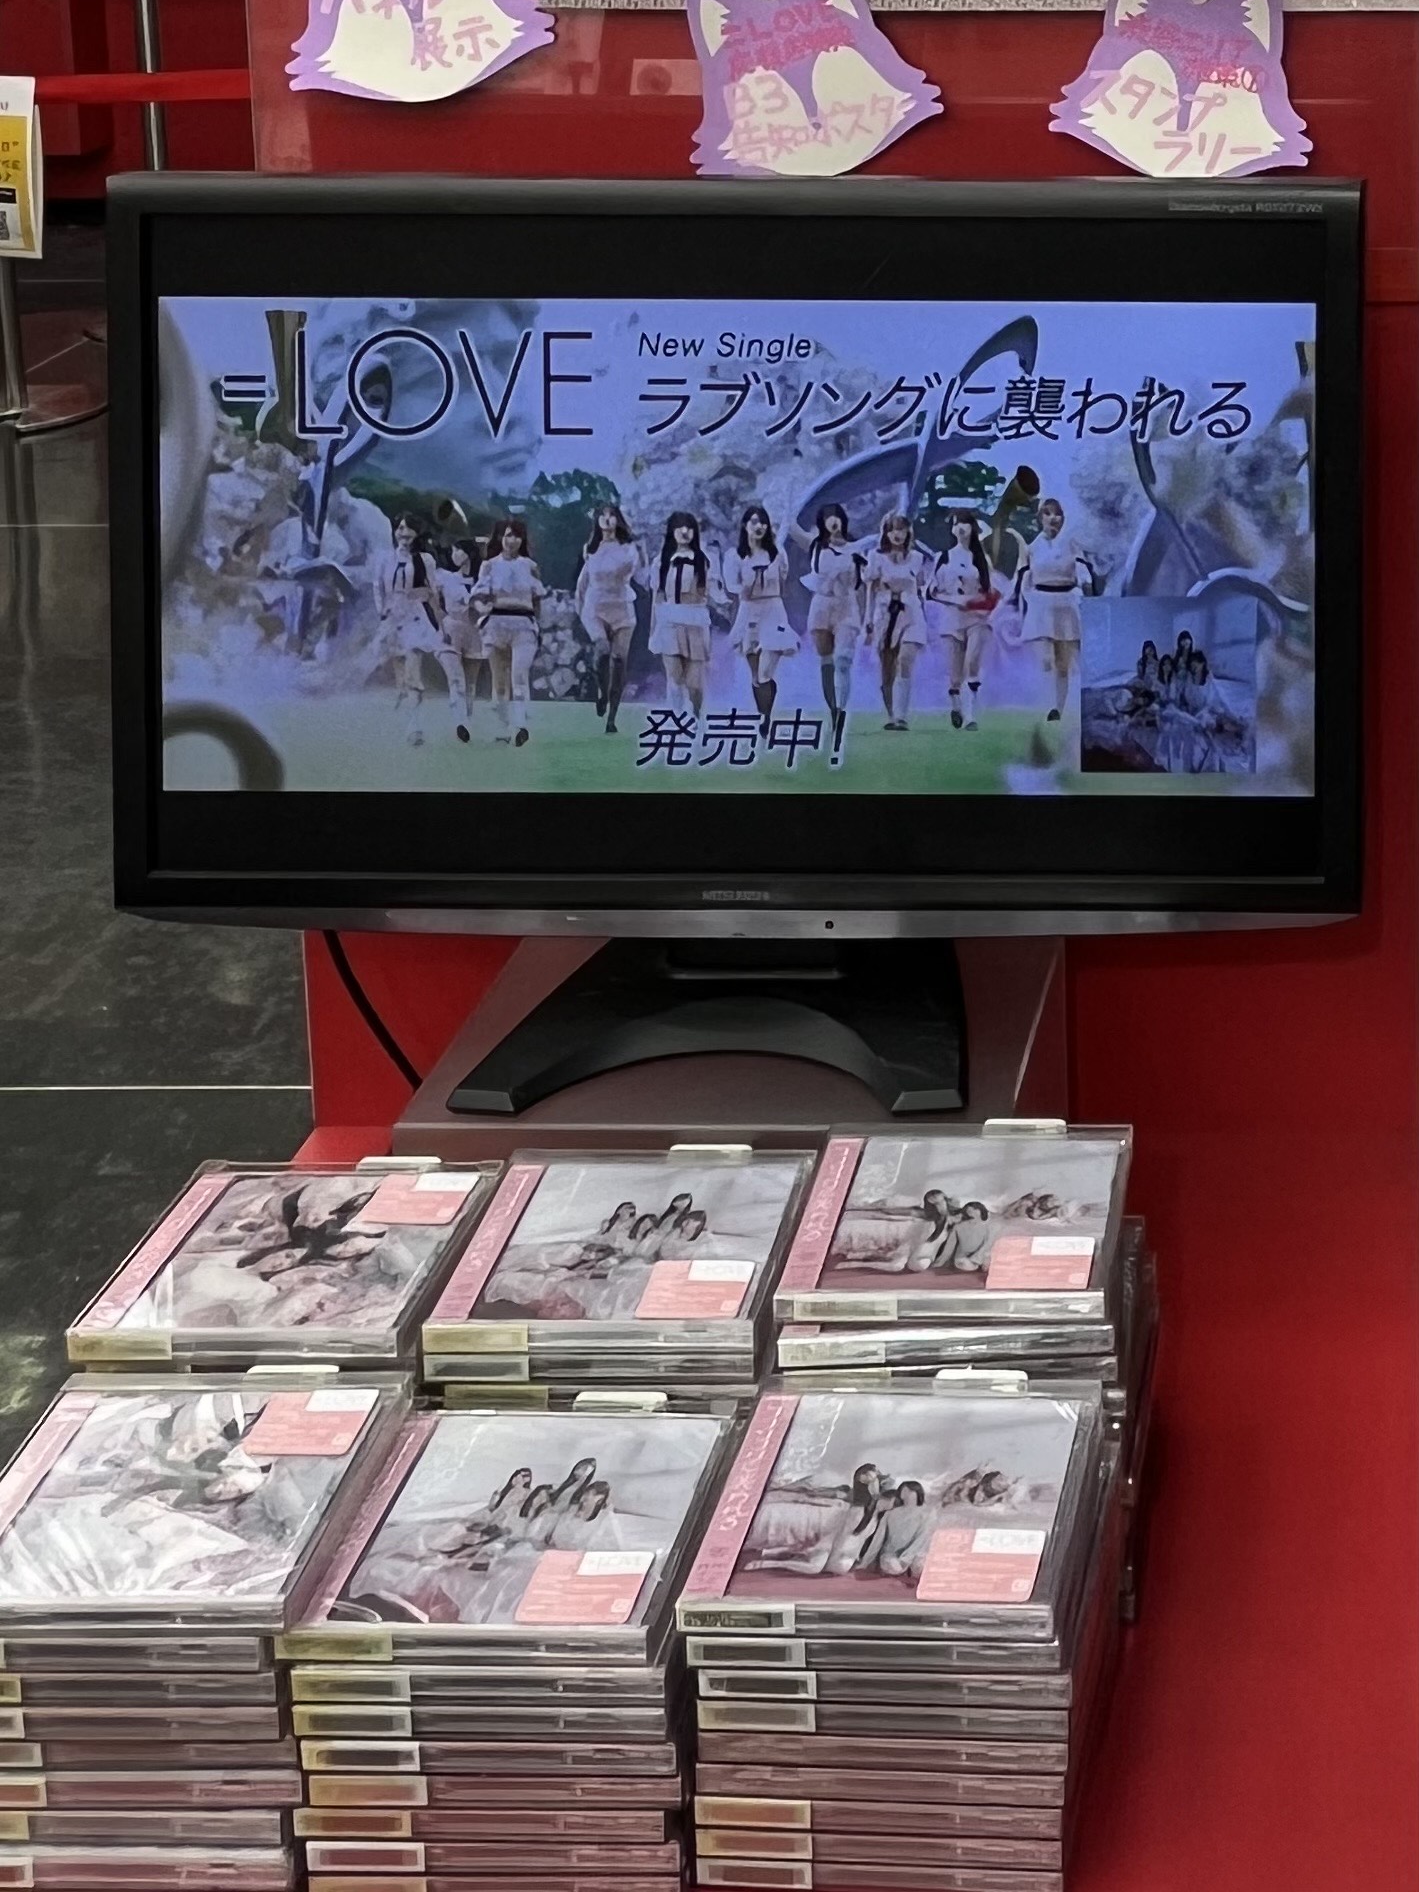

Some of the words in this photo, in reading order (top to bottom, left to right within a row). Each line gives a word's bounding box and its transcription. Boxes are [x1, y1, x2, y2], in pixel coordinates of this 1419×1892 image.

[637, 332, 706, 360] New
[715, 331, 813, 365] Single
[637, 373, 1254, 444] ラブソングに襲われる
[636, 706, 847, 769] 発売中!
